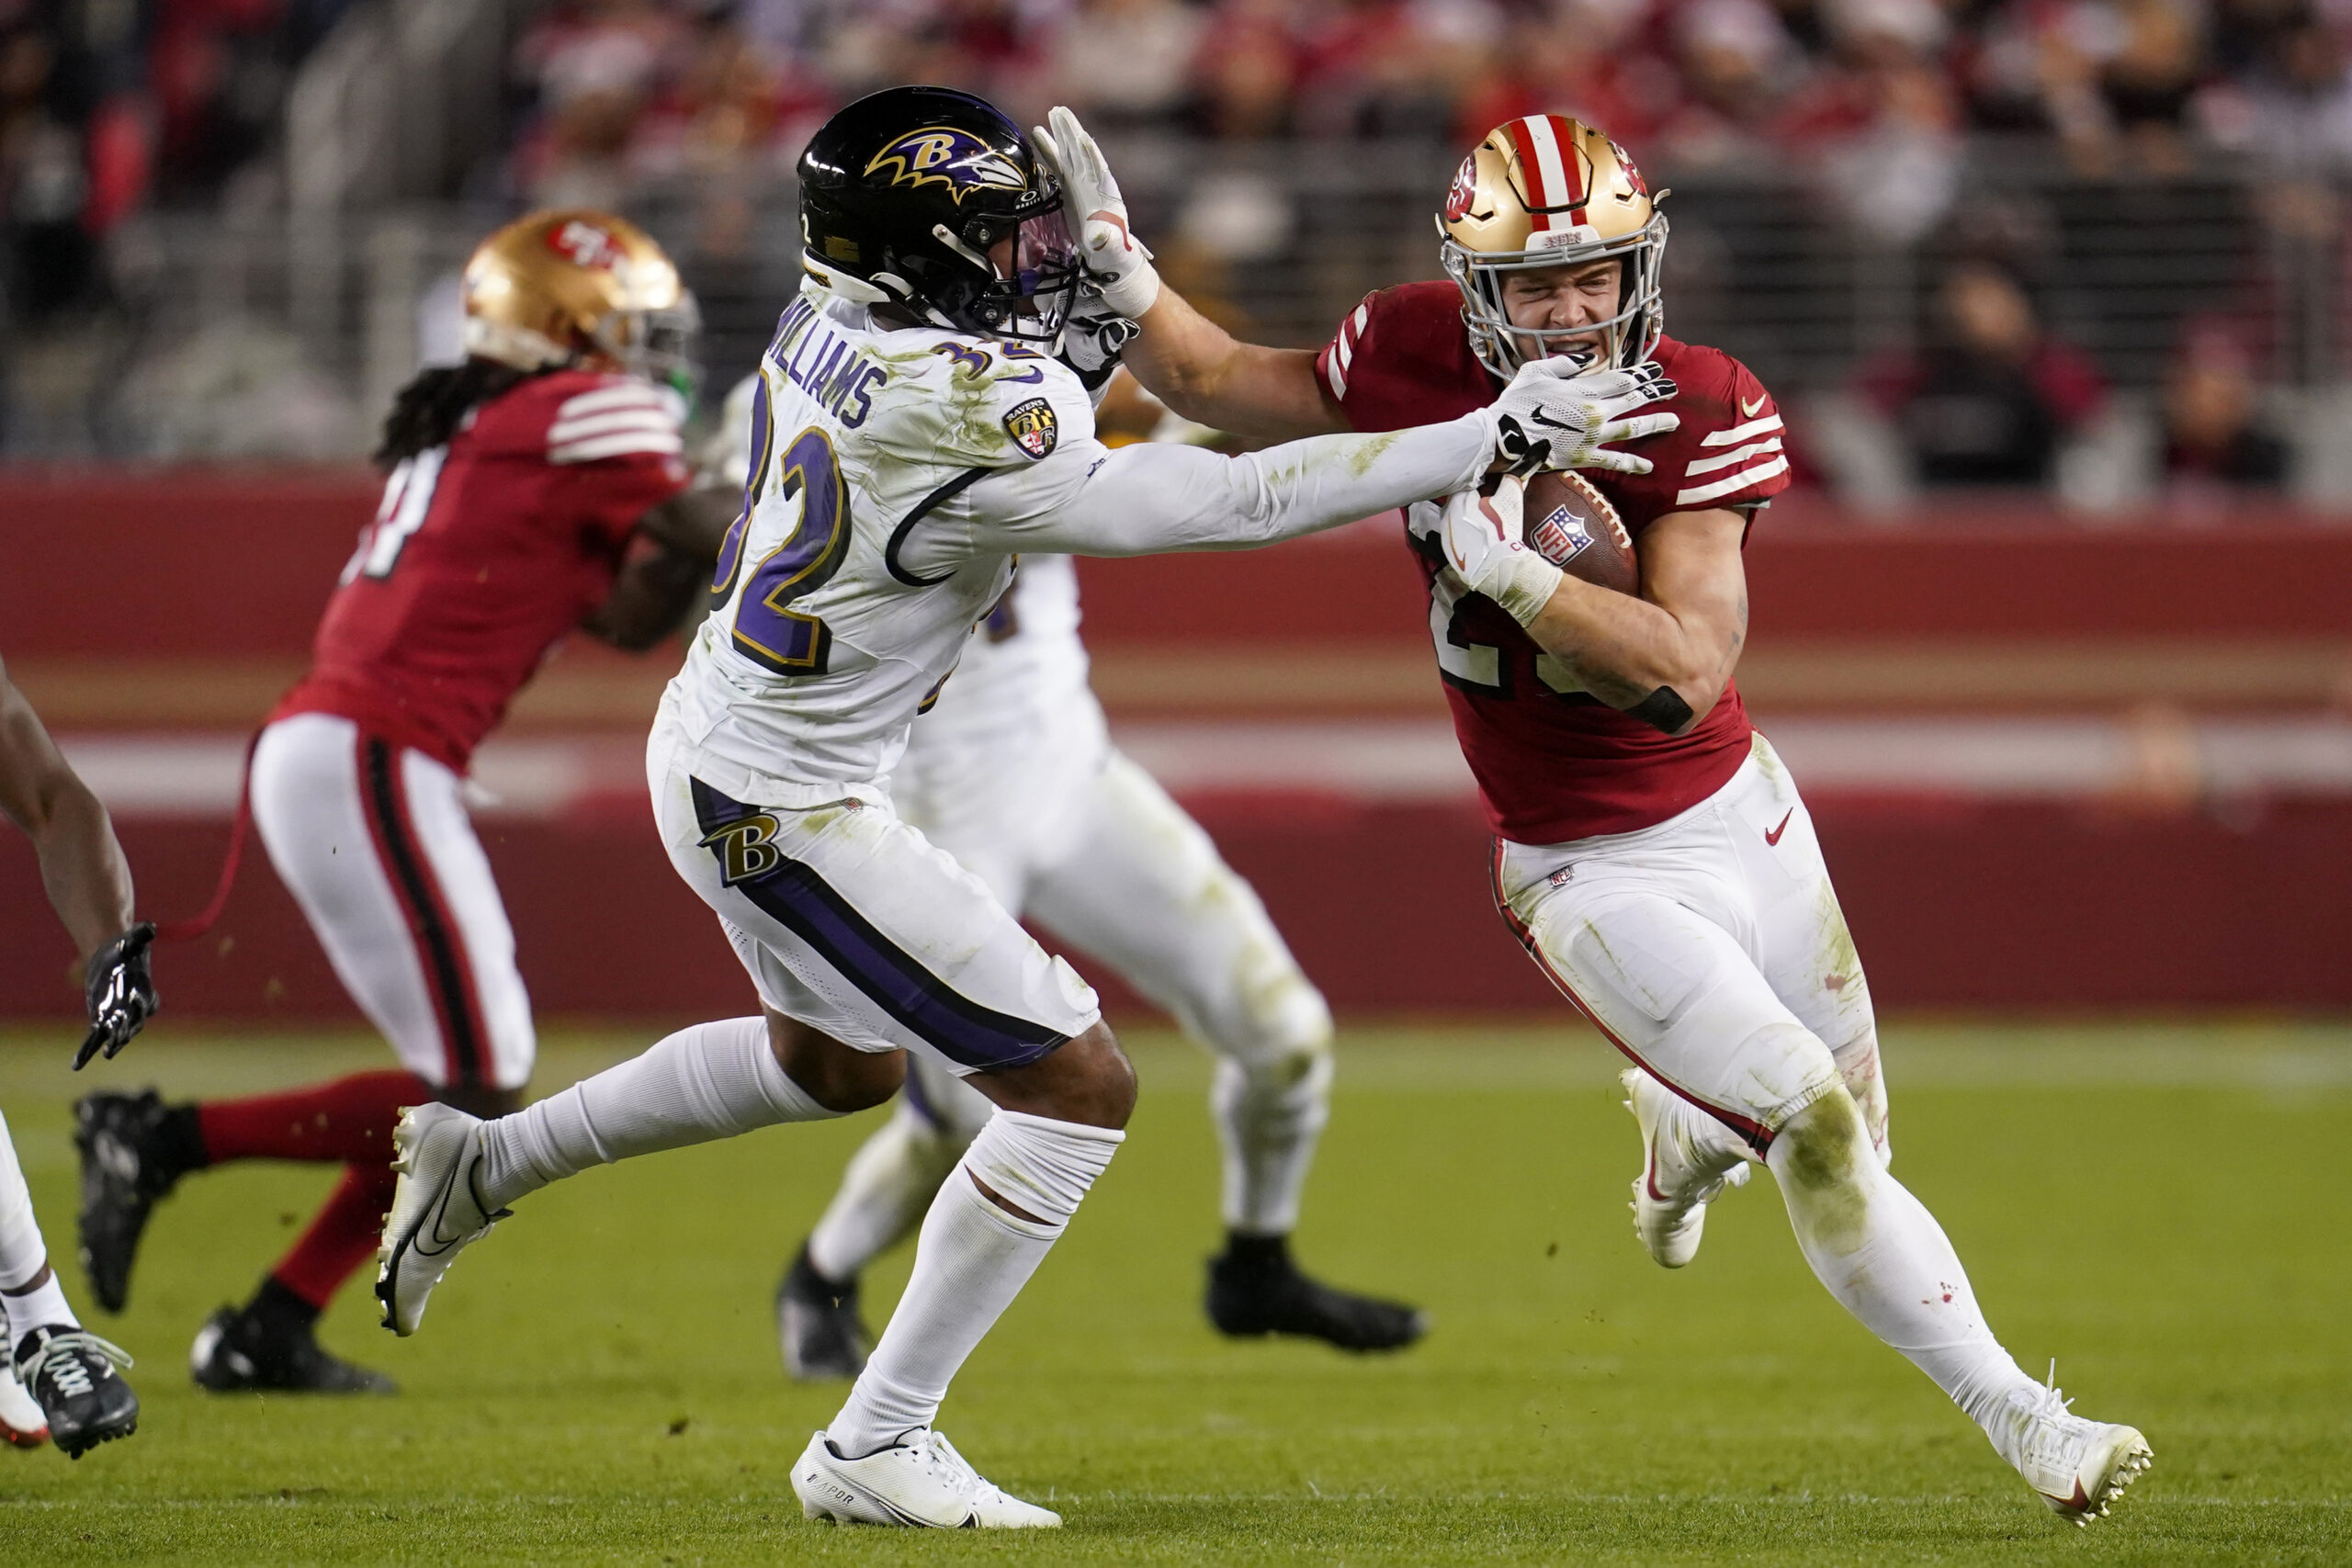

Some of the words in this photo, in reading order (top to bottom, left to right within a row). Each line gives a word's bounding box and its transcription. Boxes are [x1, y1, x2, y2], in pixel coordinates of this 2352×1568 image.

[1005, 399, 1045, 423] RAVENS
[1535, 521, 1572, 563] NFL
[696, 813, 781, 888] B
